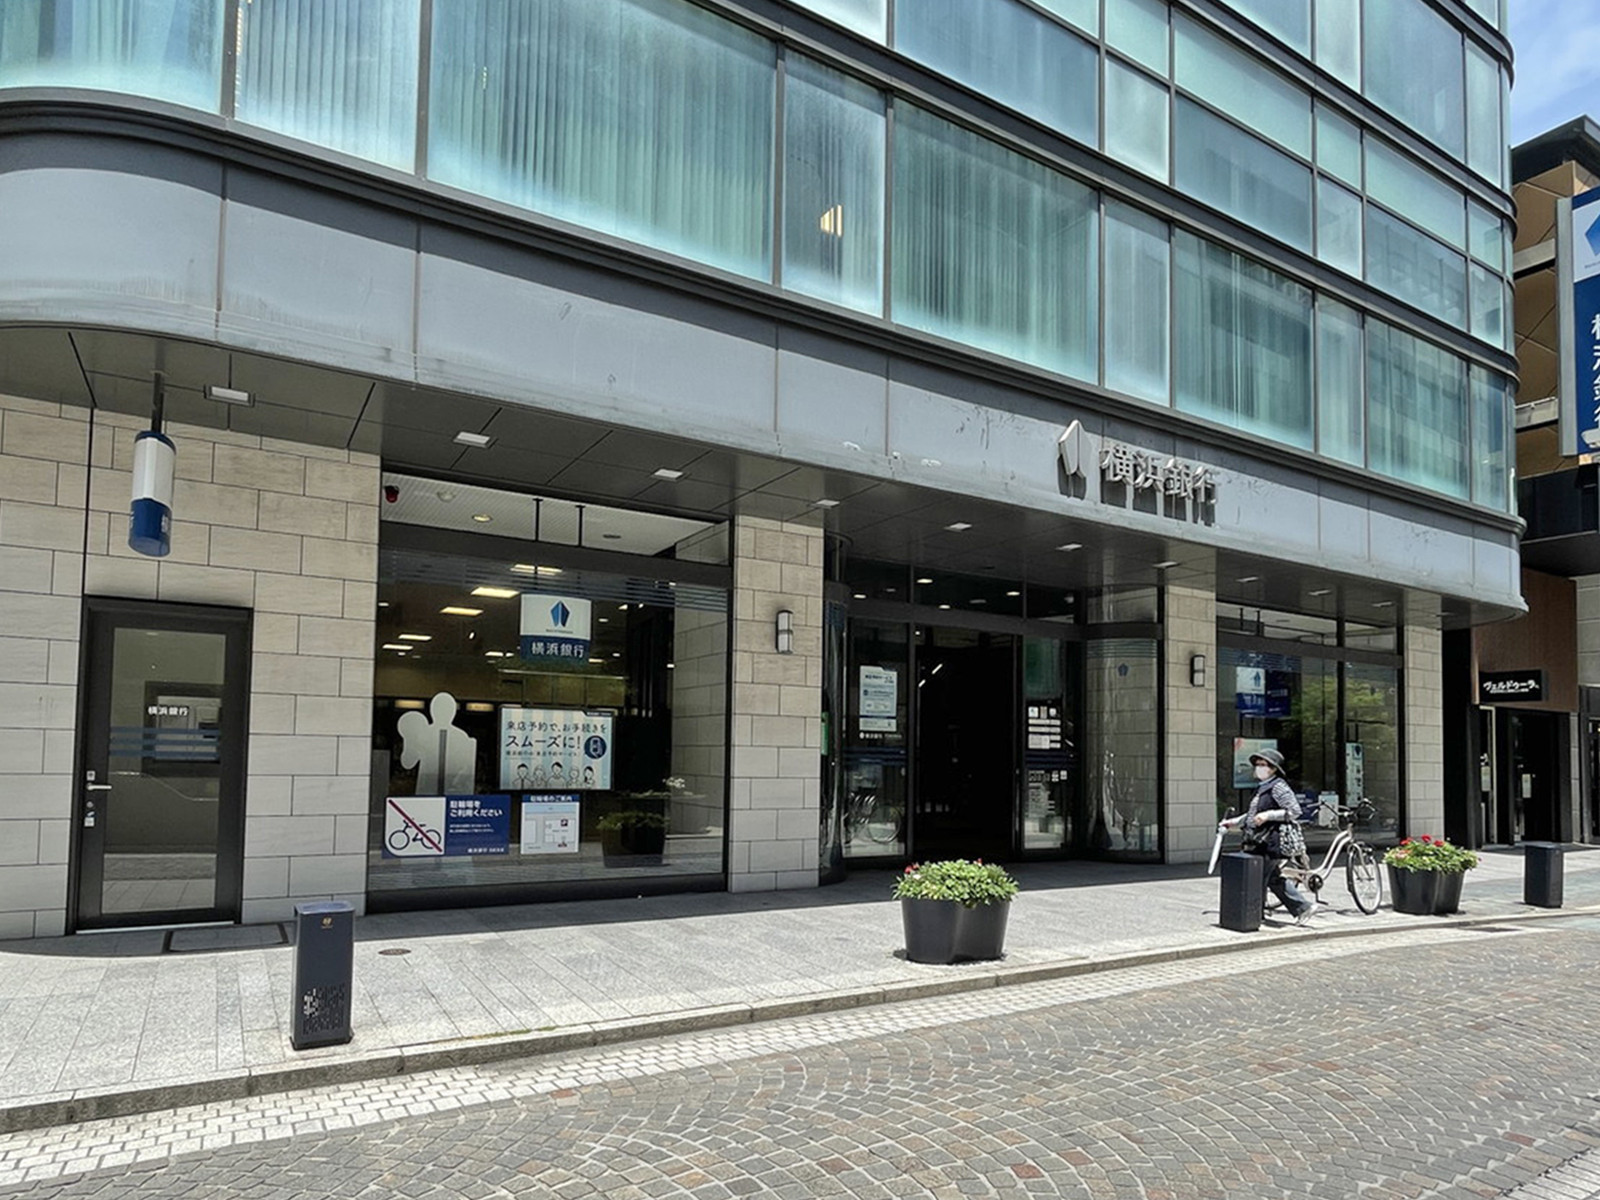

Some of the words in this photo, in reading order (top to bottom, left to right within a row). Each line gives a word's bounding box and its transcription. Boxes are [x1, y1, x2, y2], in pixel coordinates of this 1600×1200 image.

[1099, 445, 1217, 504] 横浜銀行
[532, 641, 585, 658] 横浜銀行
[505, 734, 581, 750] スムーズに!
[449, 808, 503, 818] ご利用ください
